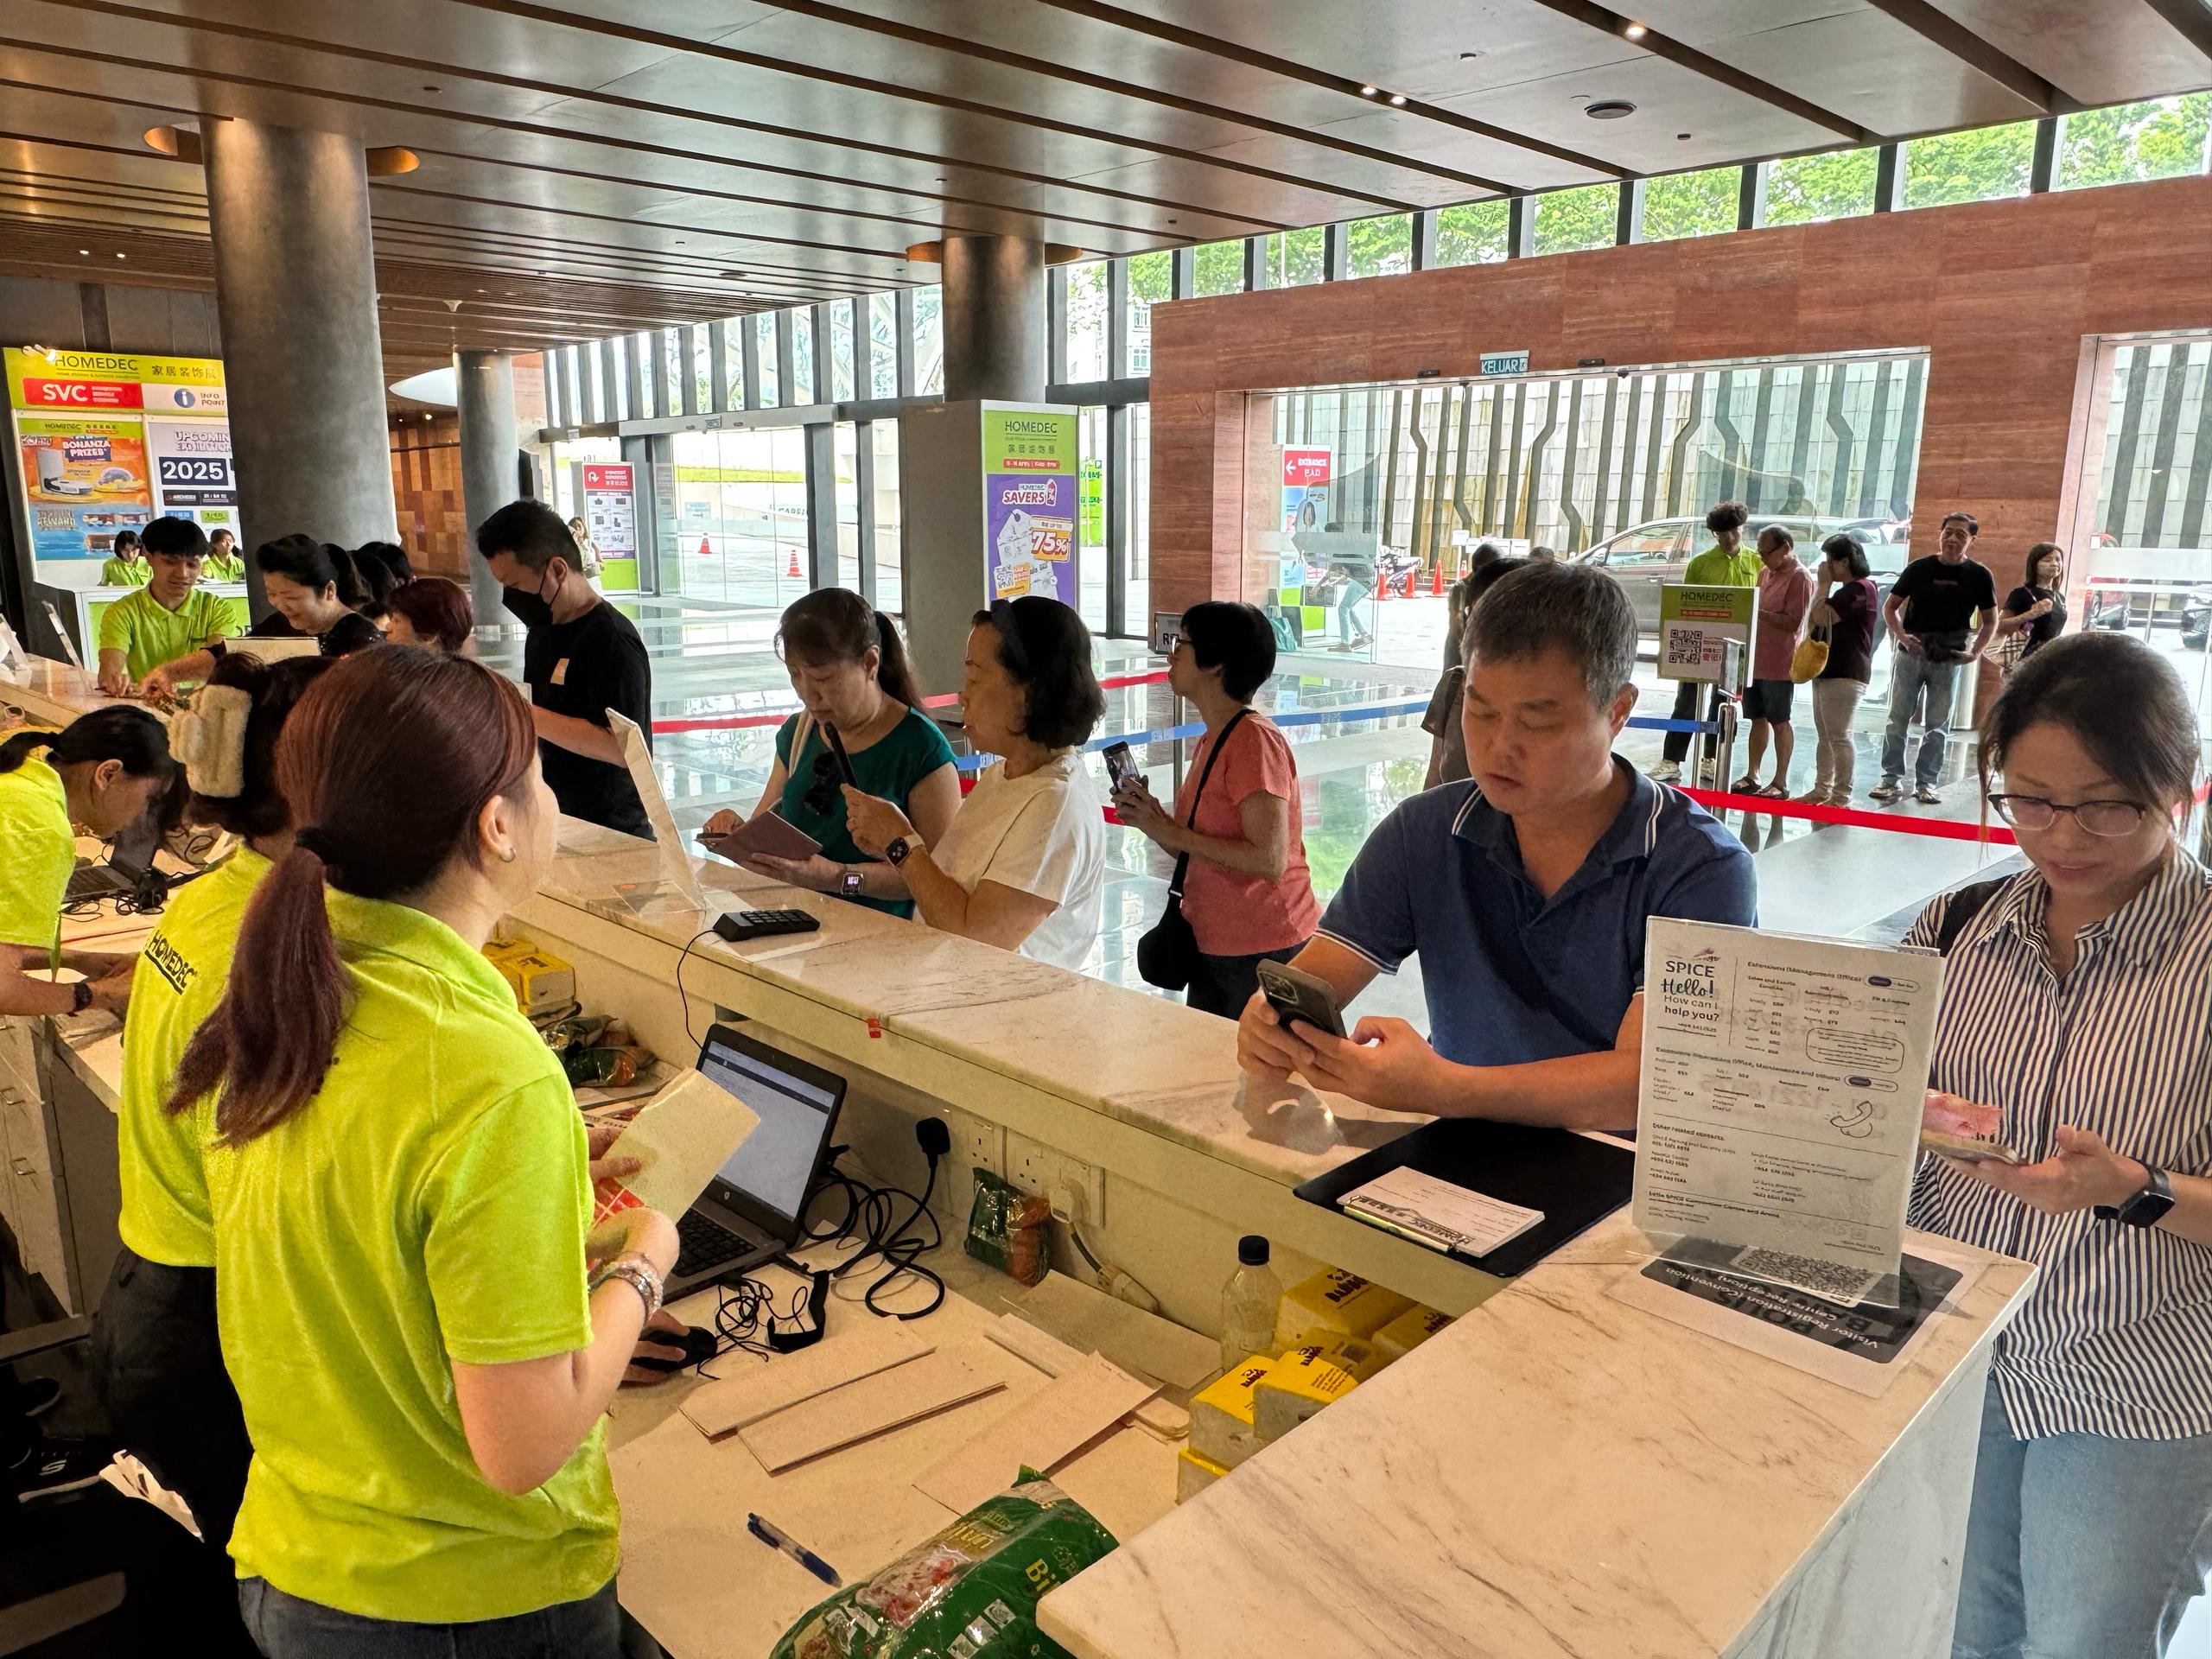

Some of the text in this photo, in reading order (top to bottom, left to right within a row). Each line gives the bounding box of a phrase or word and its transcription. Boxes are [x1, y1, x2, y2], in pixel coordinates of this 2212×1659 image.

[56, 354, 138, 371] HOMEDEC
[1481, 359, 1518, 374] KELUAR
[42, 384, 88, 402] SVC
[1005, 421, 1058, 434] HOMEDEC
[62, 441, 111, 449] BONANZA
[70, 448, 105, 457] PRIZES
[162, 461, 224, 480] 2025
[1004, 491, 1045, 504] SAVERS
[1031, 531, 1068, 555] 75%
[1681, 591, 1733, 602] HOMEDEC
[1666, 960, 1715, 978] SPICE
[1661, 978, 1713, 998] Hello!
[1664, 995, 1689, 1005] How
[1691, 1000, 1711, 1009] can
[1665, 1006, 1719, 1022] help you?
[1665, 1268, 1878, 1348] Visitor Registration (Convention
